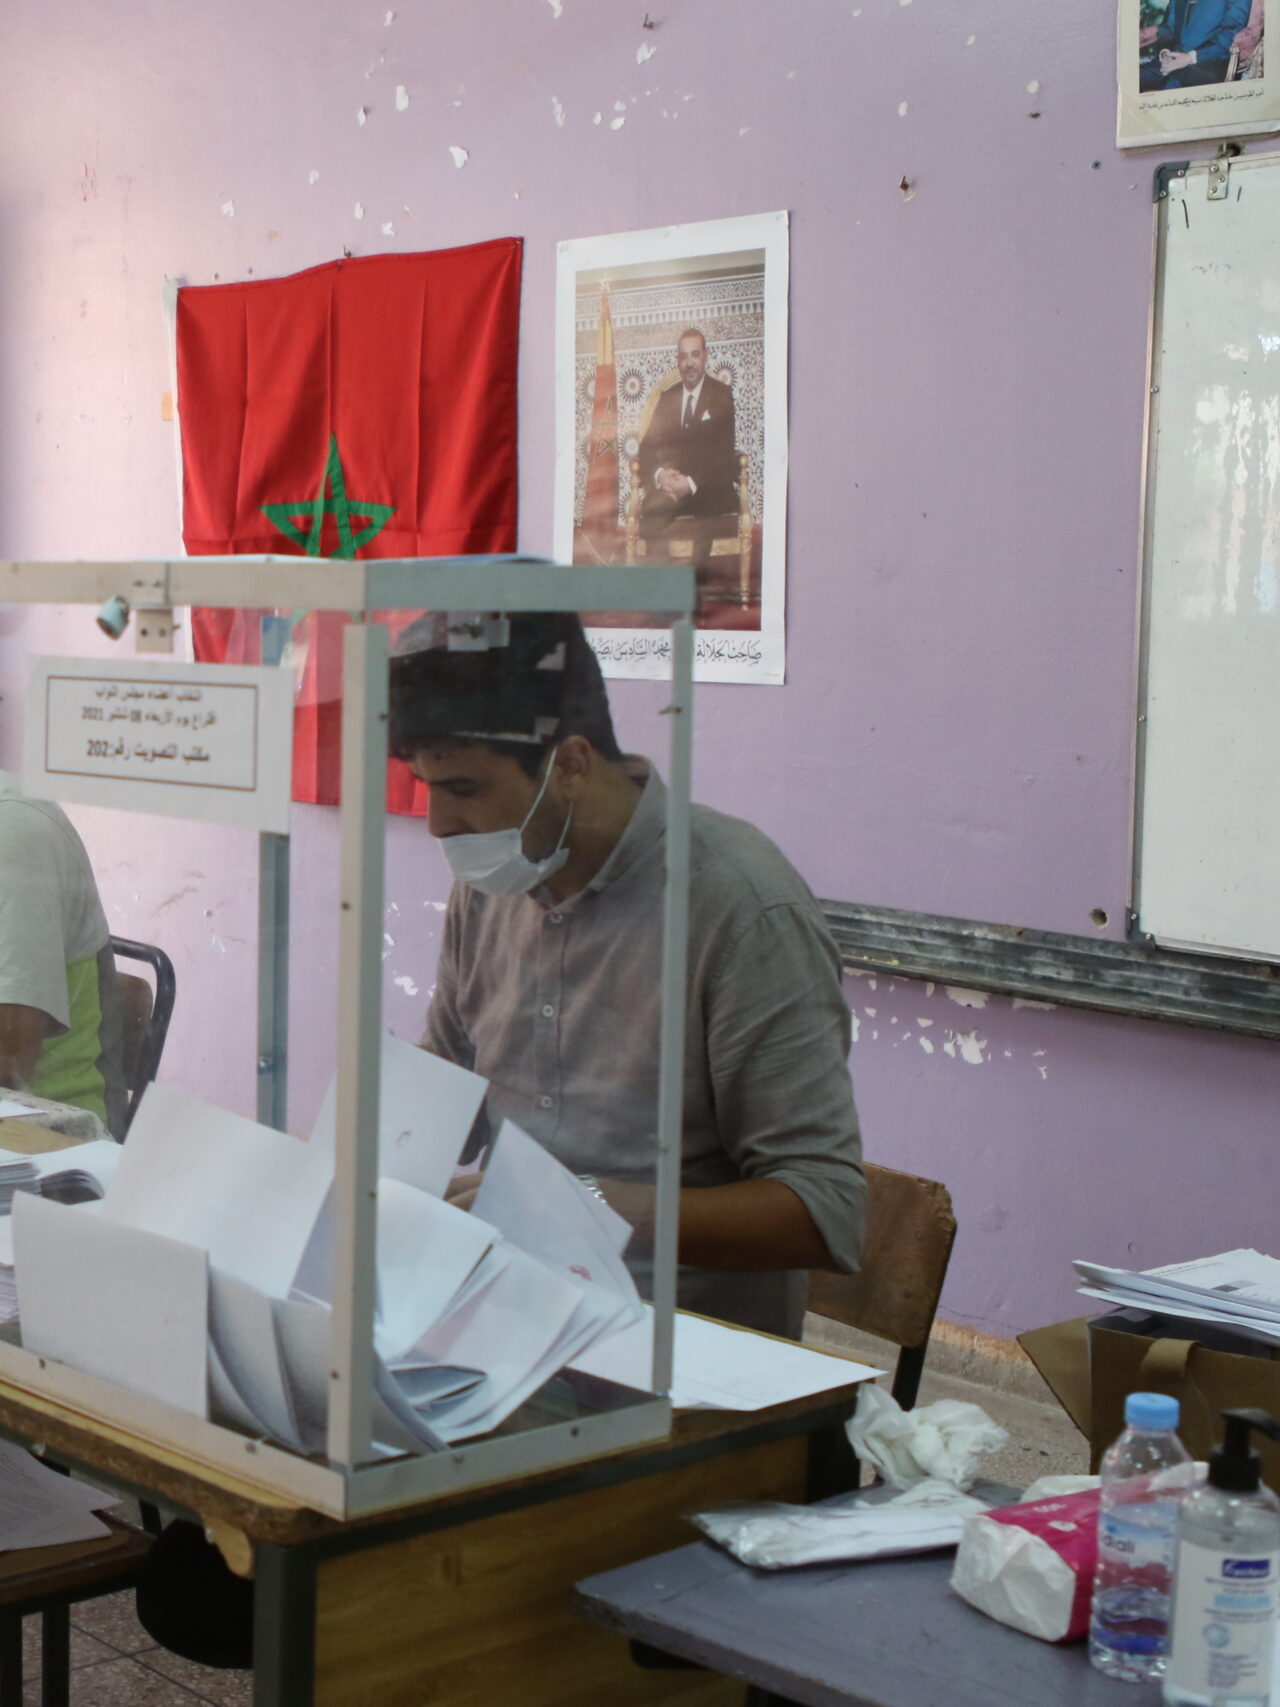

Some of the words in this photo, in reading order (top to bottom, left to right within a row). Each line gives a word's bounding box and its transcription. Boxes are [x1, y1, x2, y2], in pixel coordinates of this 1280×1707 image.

[81, 704, 103, 720] 2021
[130, 708, 141, 723] 08
[134, 743, 177, 762] التصويت
[182, 745, 210, 765] مكتب
